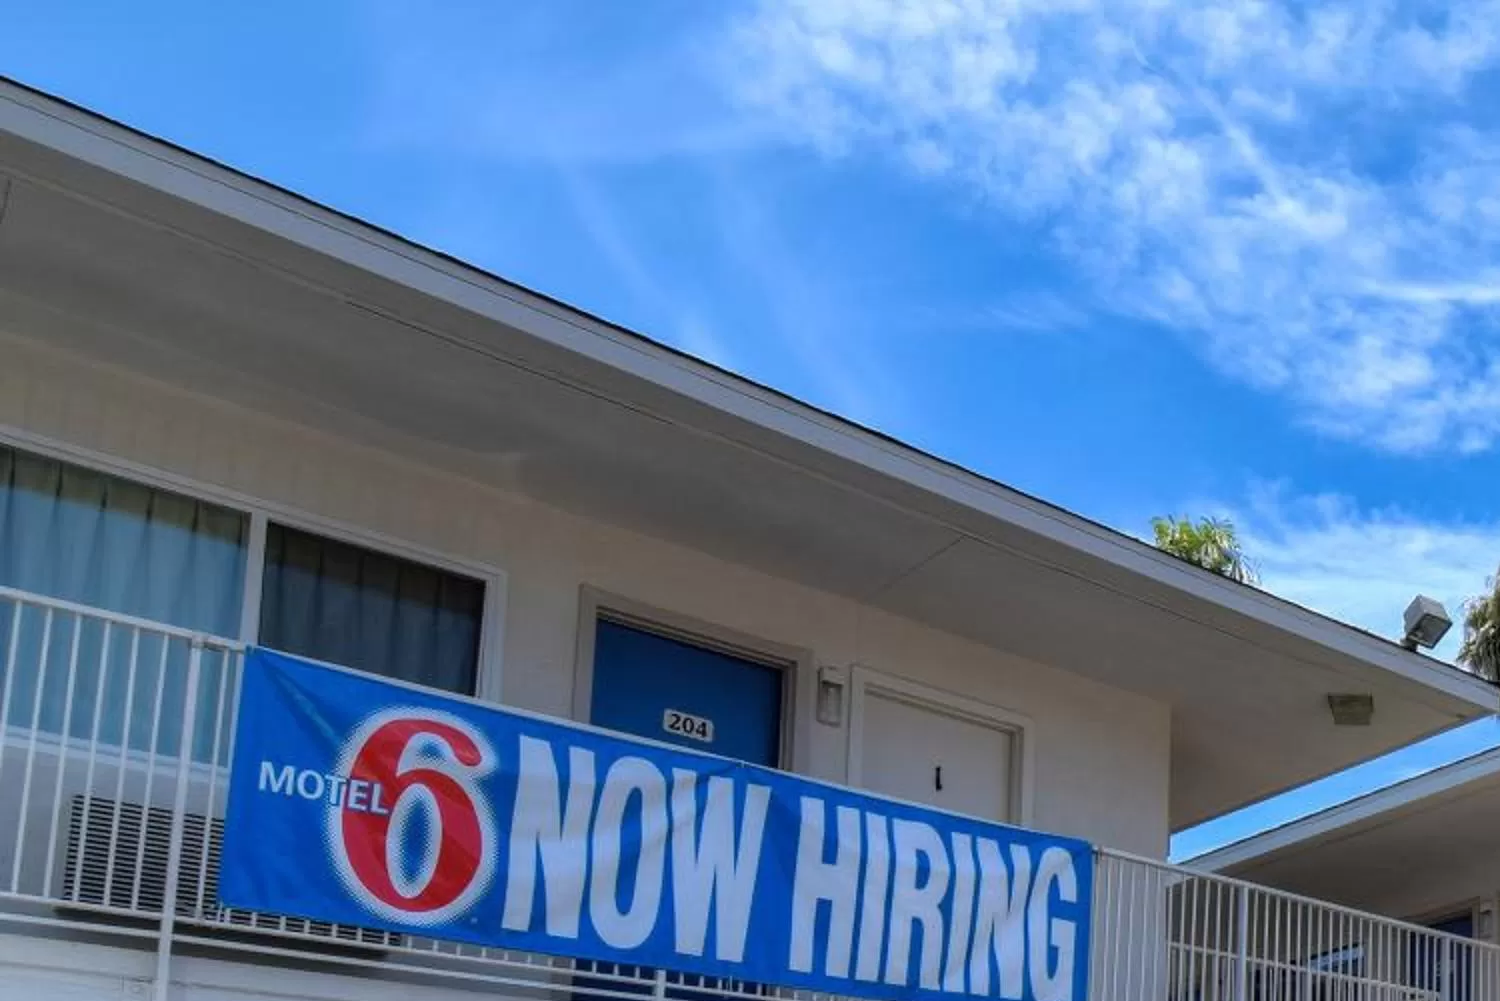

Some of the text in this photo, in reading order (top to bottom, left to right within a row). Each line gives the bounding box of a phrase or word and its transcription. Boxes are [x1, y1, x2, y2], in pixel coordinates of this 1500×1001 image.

[258, 711, 494, 921] MOTEL 6
[669, 713, 707, 738] 204
[501, 735, 773, 963] NOW
